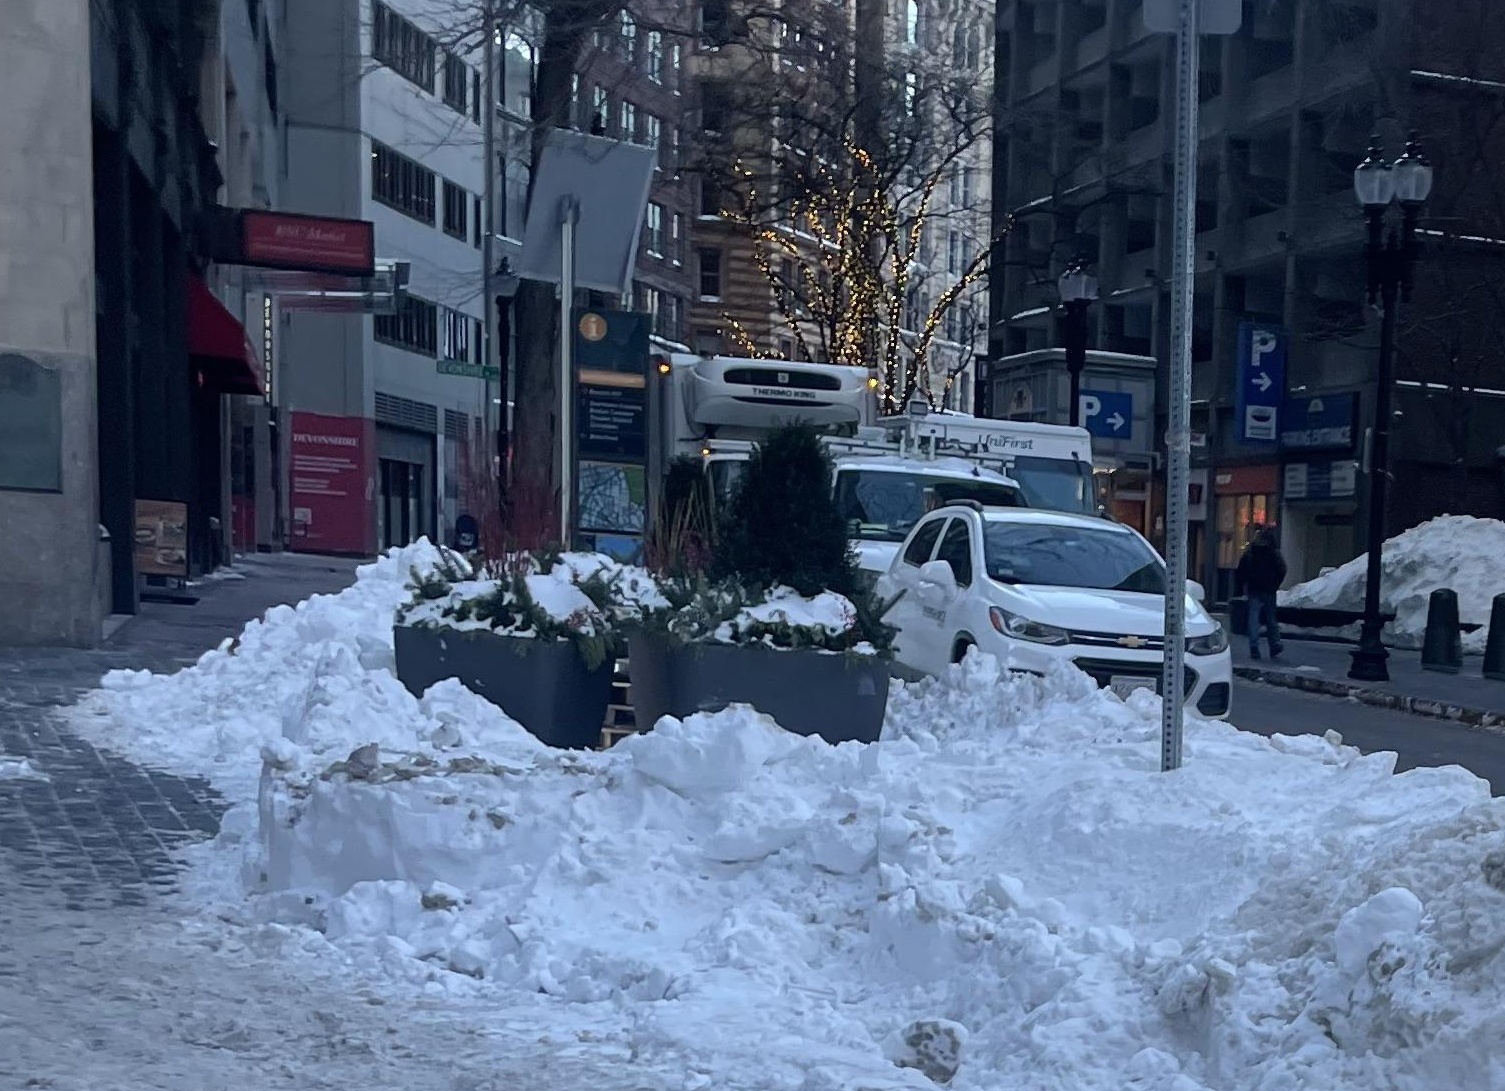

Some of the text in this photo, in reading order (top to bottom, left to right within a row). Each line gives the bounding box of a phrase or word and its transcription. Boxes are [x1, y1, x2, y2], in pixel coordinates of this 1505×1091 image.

[1251, 330, 1276, 366] P
[752, 387, 816, 399] THERMO KING
[1079, 394, 1101, 428] P
